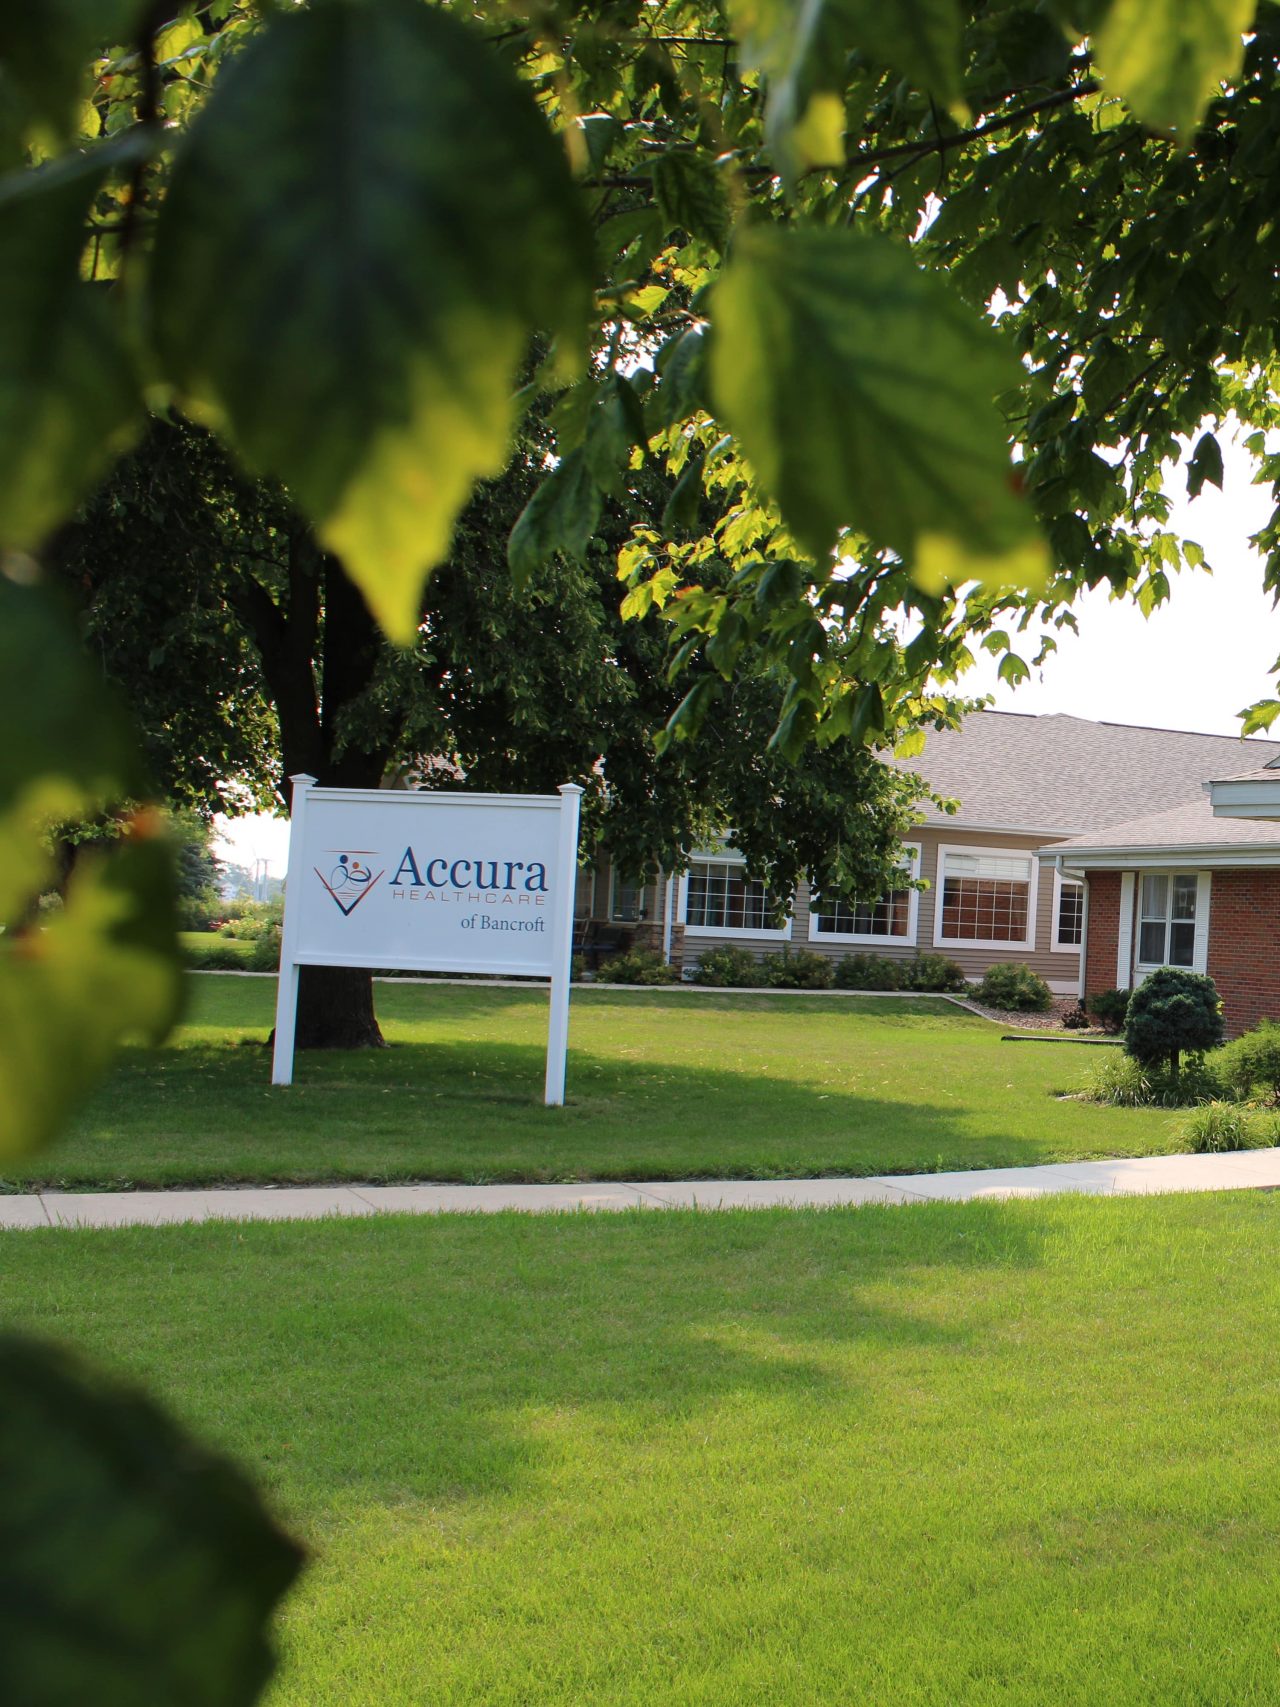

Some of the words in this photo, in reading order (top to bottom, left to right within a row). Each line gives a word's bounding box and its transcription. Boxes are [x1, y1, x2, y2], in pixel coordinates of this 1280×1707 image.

[388, 846, 549, 892] Accura
[392, 890, 545, 906] HEALTHCARE
[460, 914, 478, 930] of
[480, 915, 545, 933] Bancroft
